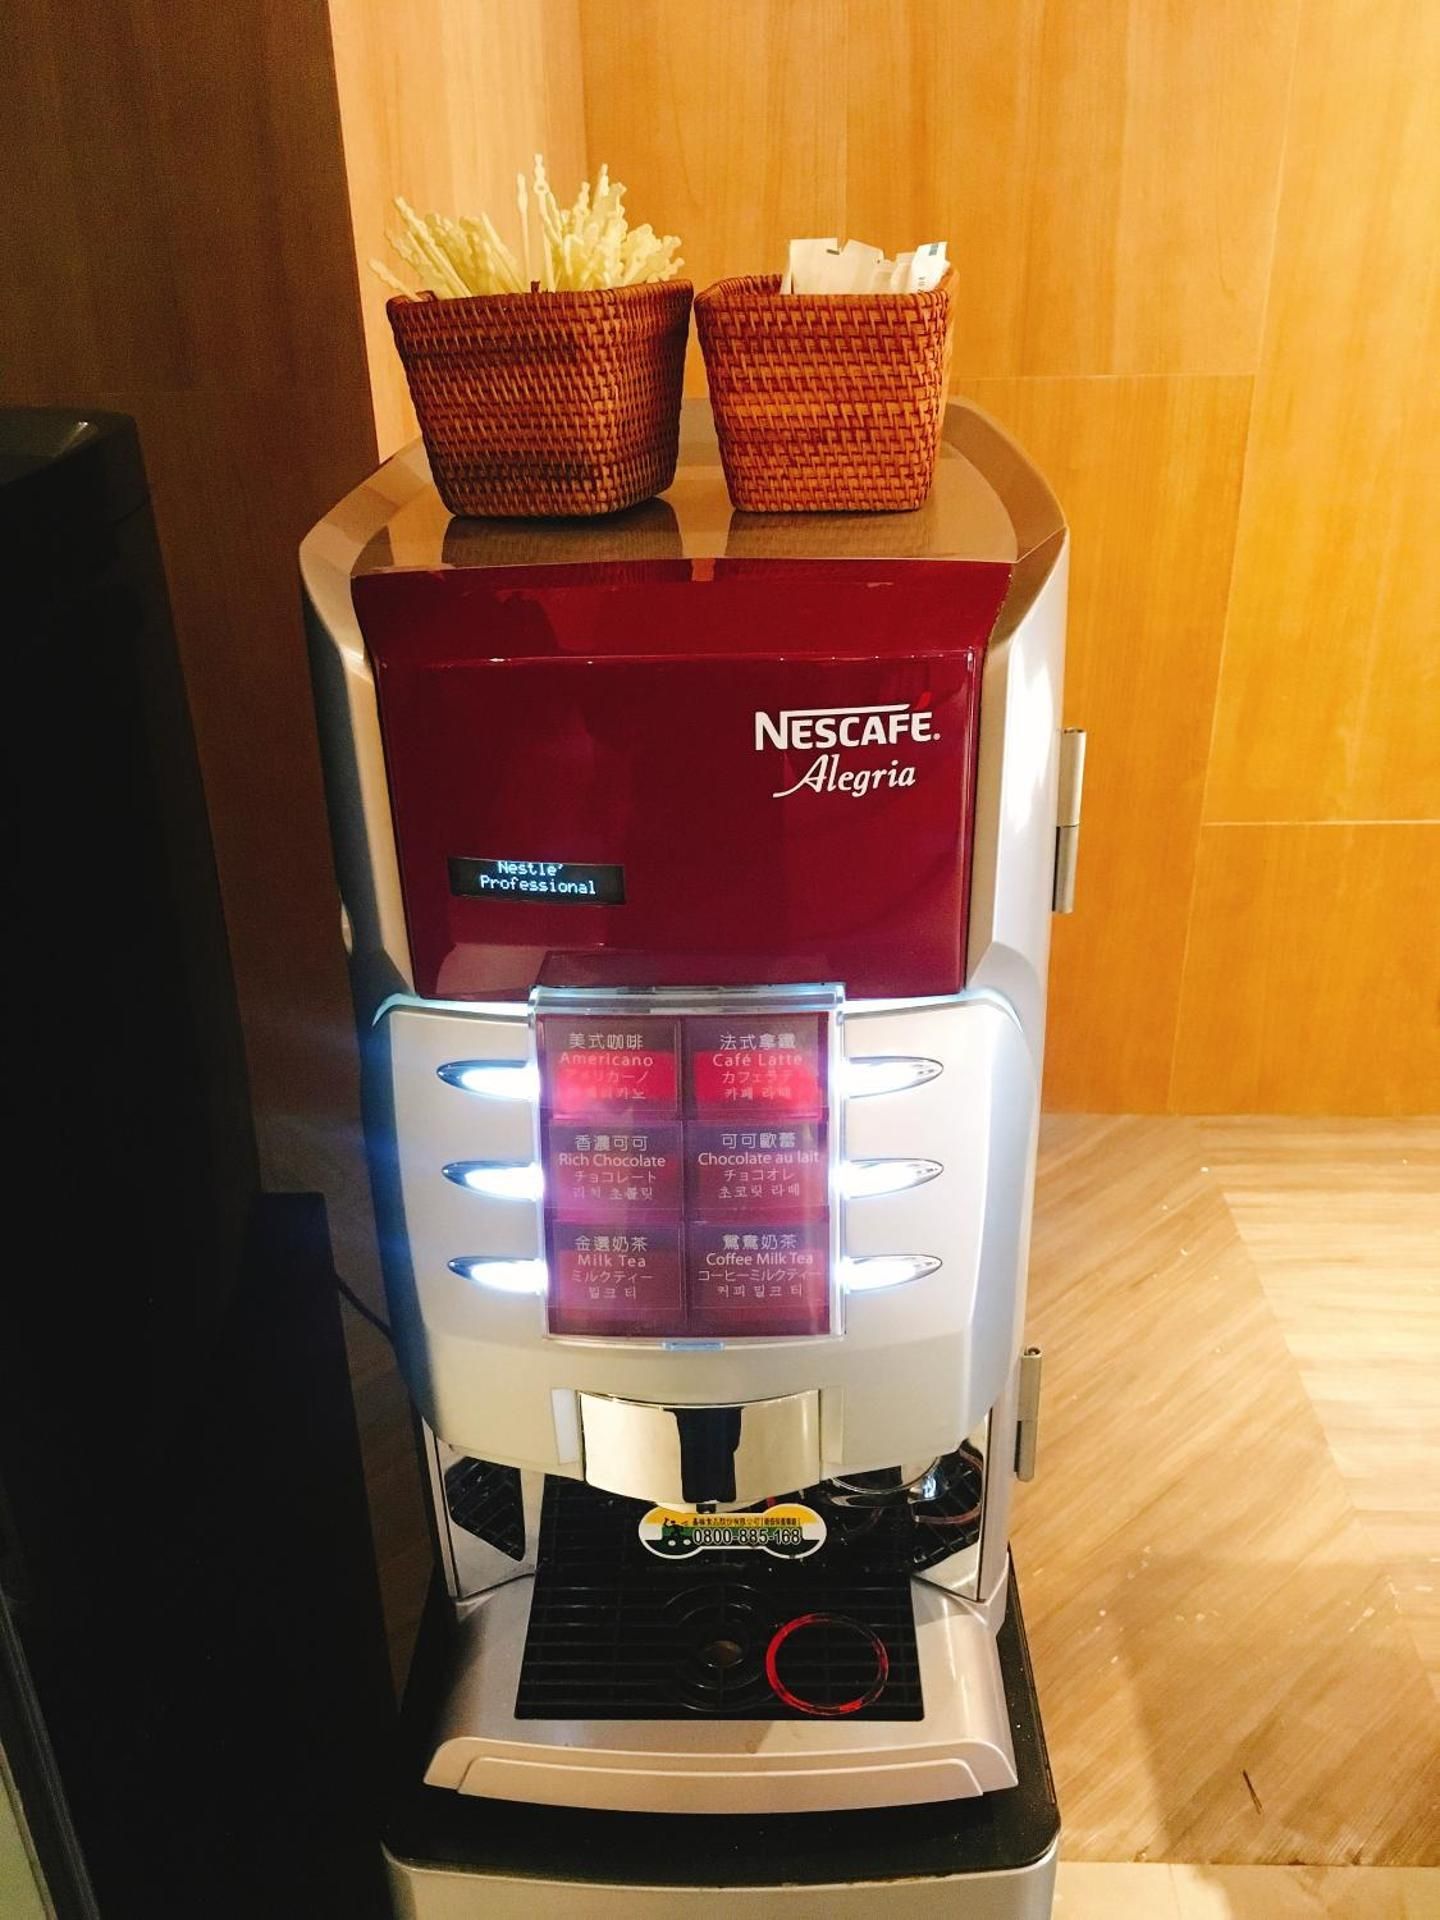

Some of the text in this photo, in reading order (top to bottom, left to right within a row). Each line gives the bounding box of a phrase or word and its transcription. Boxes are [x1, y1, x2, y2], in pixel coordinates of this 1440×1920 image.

[772, 754, 916, 798] Alegria
[479, 875, 596, 895] Professional
[568, 1033, 644, 1050] 美式咖啡
[560, 1051, 654, 1067] Americano
[712, 1052, 803, 1067] Café Latte
[559, 1153, 666, 1168] Rich Chocolate
[698, 1150, 820, 1166] Chocolate au lait
[575, 1170, 657, 1185] チョコレート
[578, 1254, 646, 1268] Milk Tea
[706, 1252, 814, 1266] Coffee Milk Tea
[692, 1527, 801, 1546] 0800-885-168
